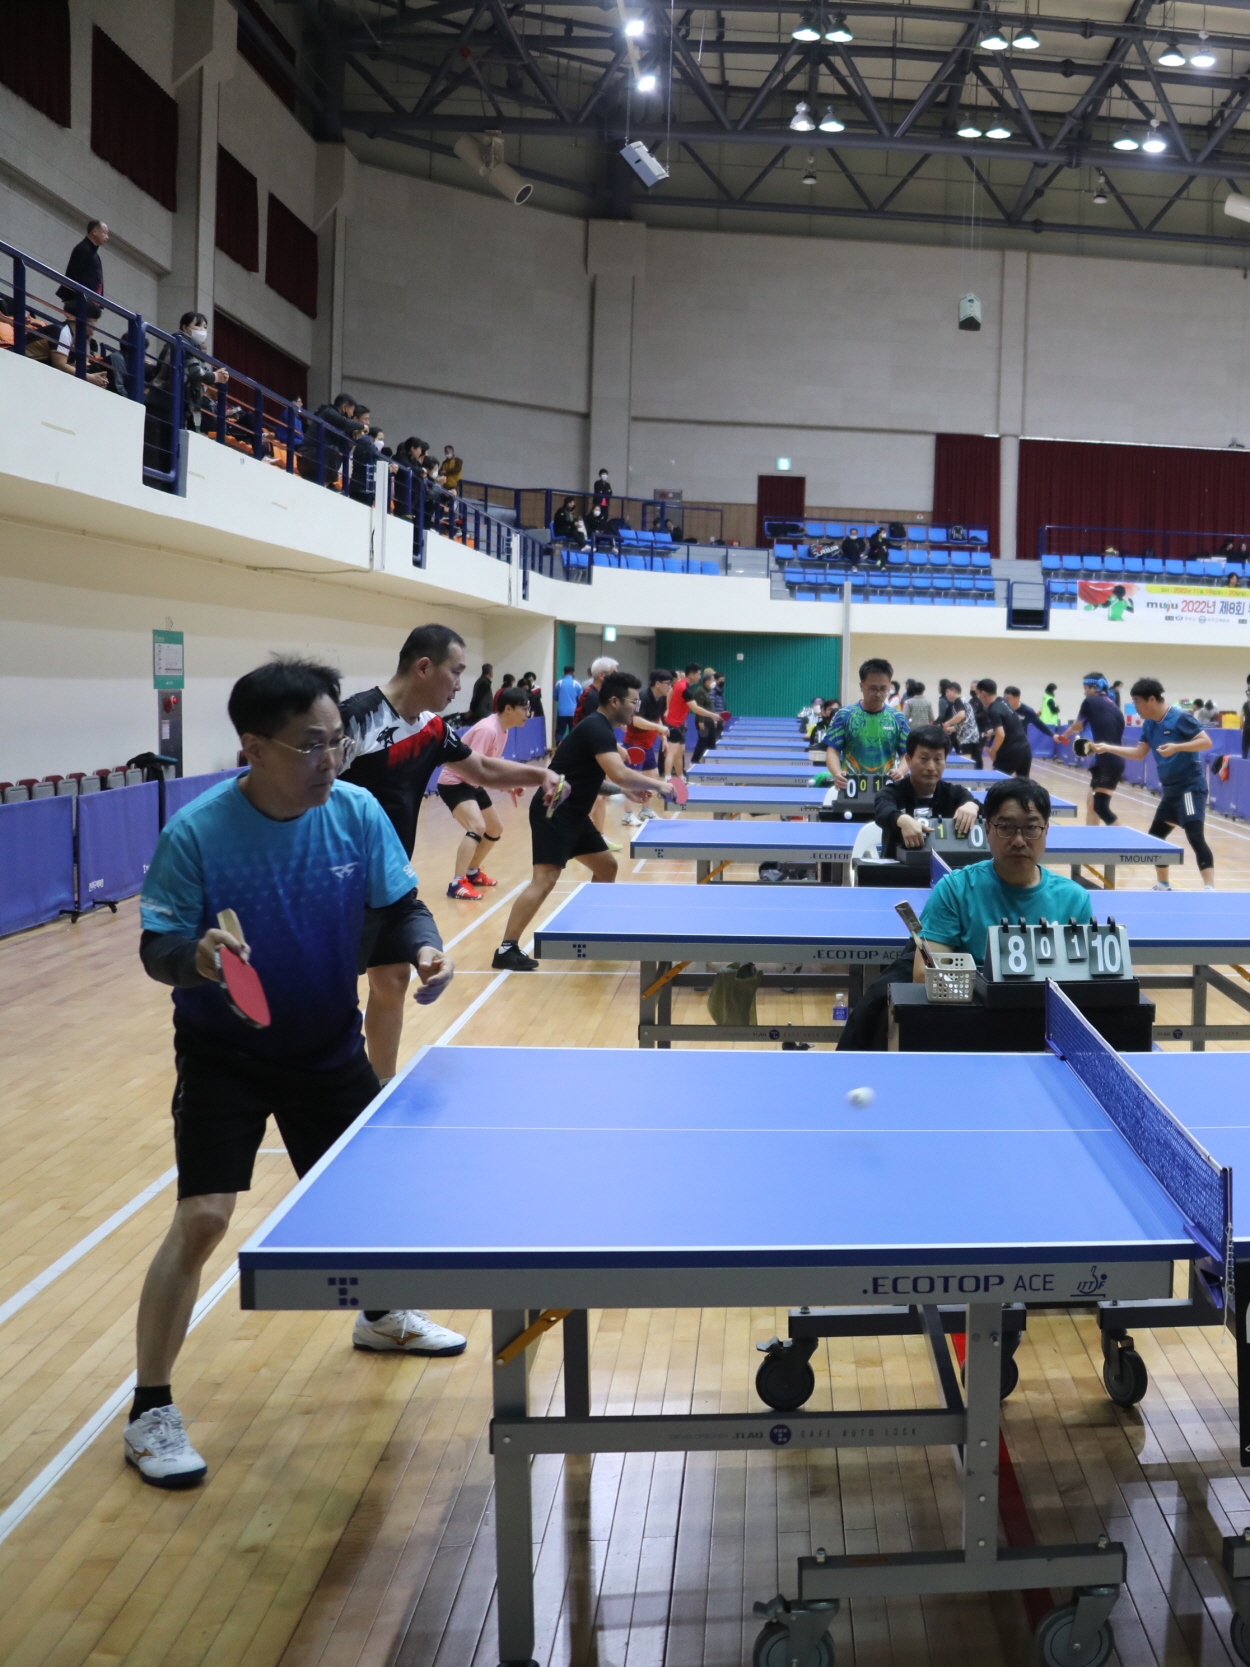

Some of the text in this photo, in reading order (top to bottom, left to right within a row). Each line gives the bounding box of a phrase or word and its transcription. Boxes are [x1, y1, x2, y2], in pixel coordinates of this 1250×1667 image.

[1181, 600, 1217, 614] 2022년
[1219, 601, 1245, 616] 제8회
[970, 825, 984, 847] 0
[1119, 855, 1159, 863] TMOUNT
[1007, 934, 1122, 974] 8 0 1 10
[1013, 1274, 1055, 1292] ACE
